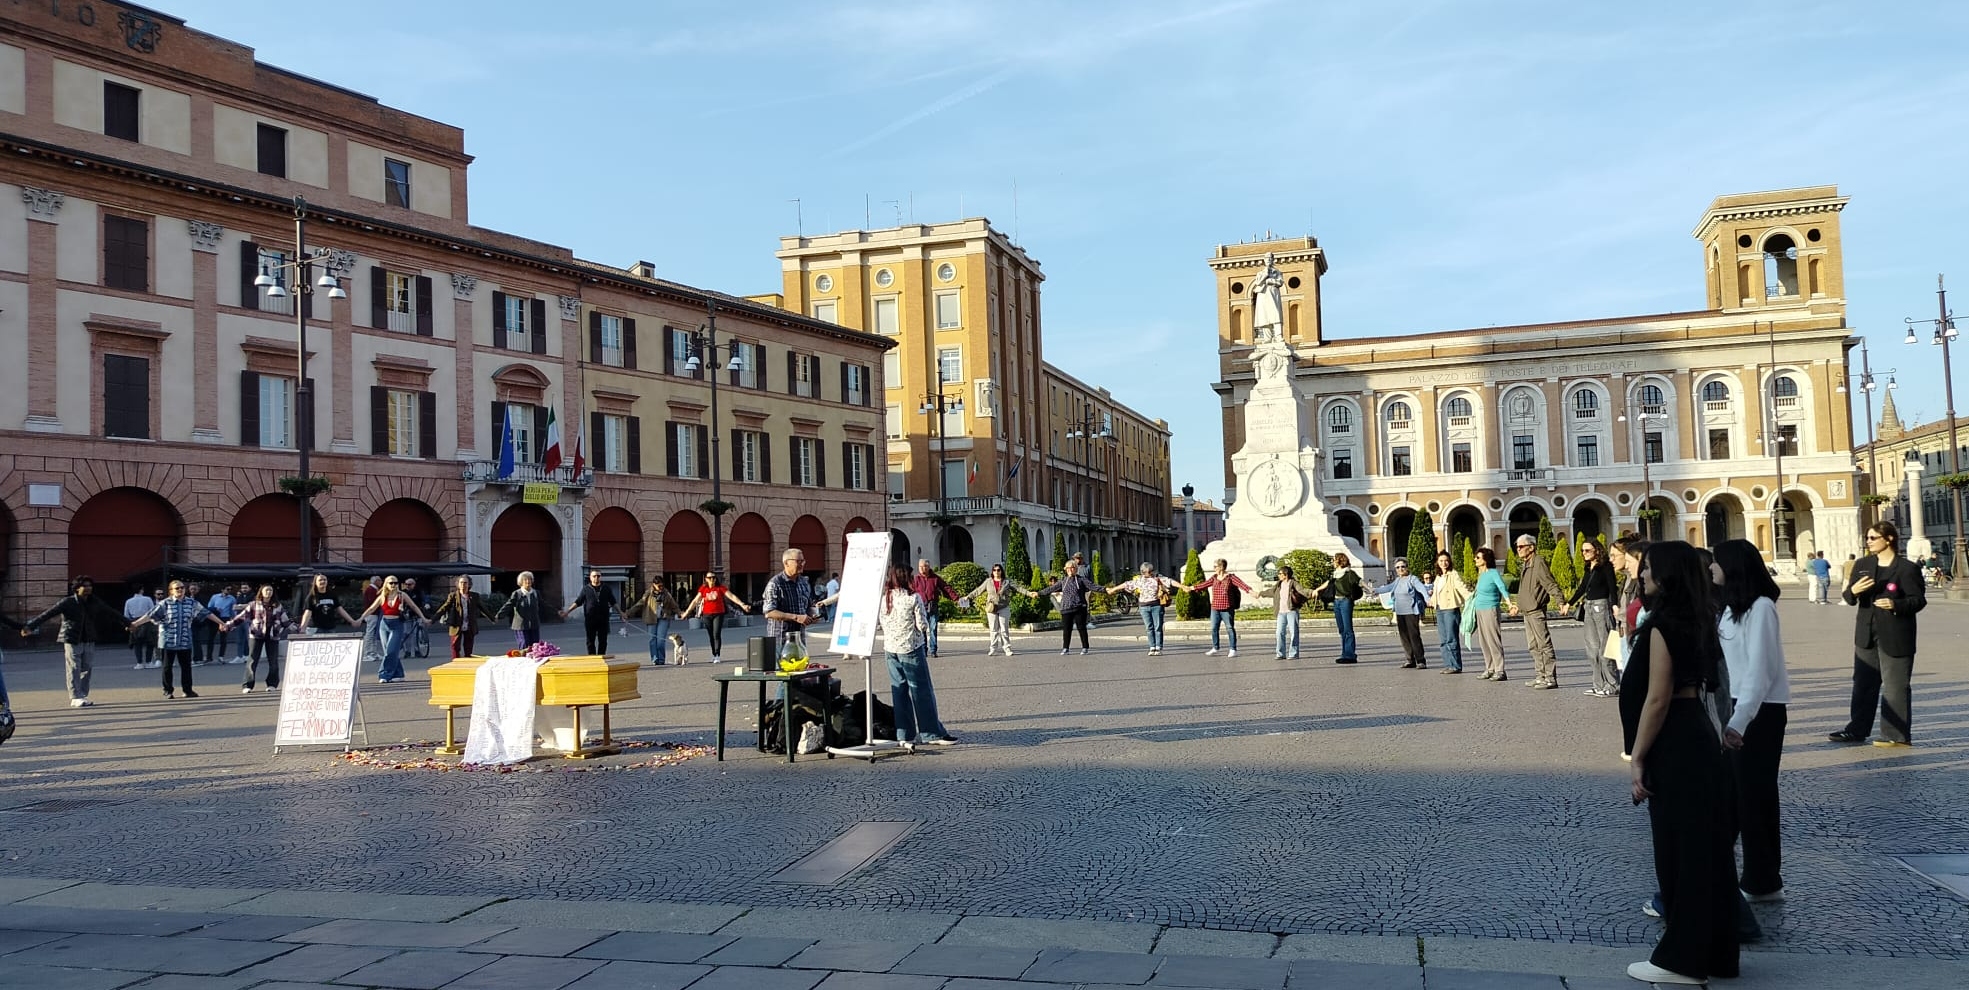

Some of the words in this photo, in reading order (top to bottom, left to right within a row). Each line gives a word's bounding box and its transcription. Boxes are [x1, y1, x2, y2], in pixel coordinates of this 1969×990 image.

[1409, 373, 1459, 384] PALAZZO
[1465, 370, 1495, 380] DELLE
[1501, 367, 1534, 377] POSTE
[1540, 366, 1545, 375] E
[1552, 365, 1568, 374] DEI
[1573, 360, 1638, 373] TELEGRAFI
[335, 641, 352, 655] FOR
[304, 655, 345, 669] EQUALITY
[288, 672, 306, 684] UNA
[309, 672, 334, 685] BARA
[336, 671, 352, 684] PER
[283, 702, 295, 713] LE
[296, 700, 323, 713] DONNE
